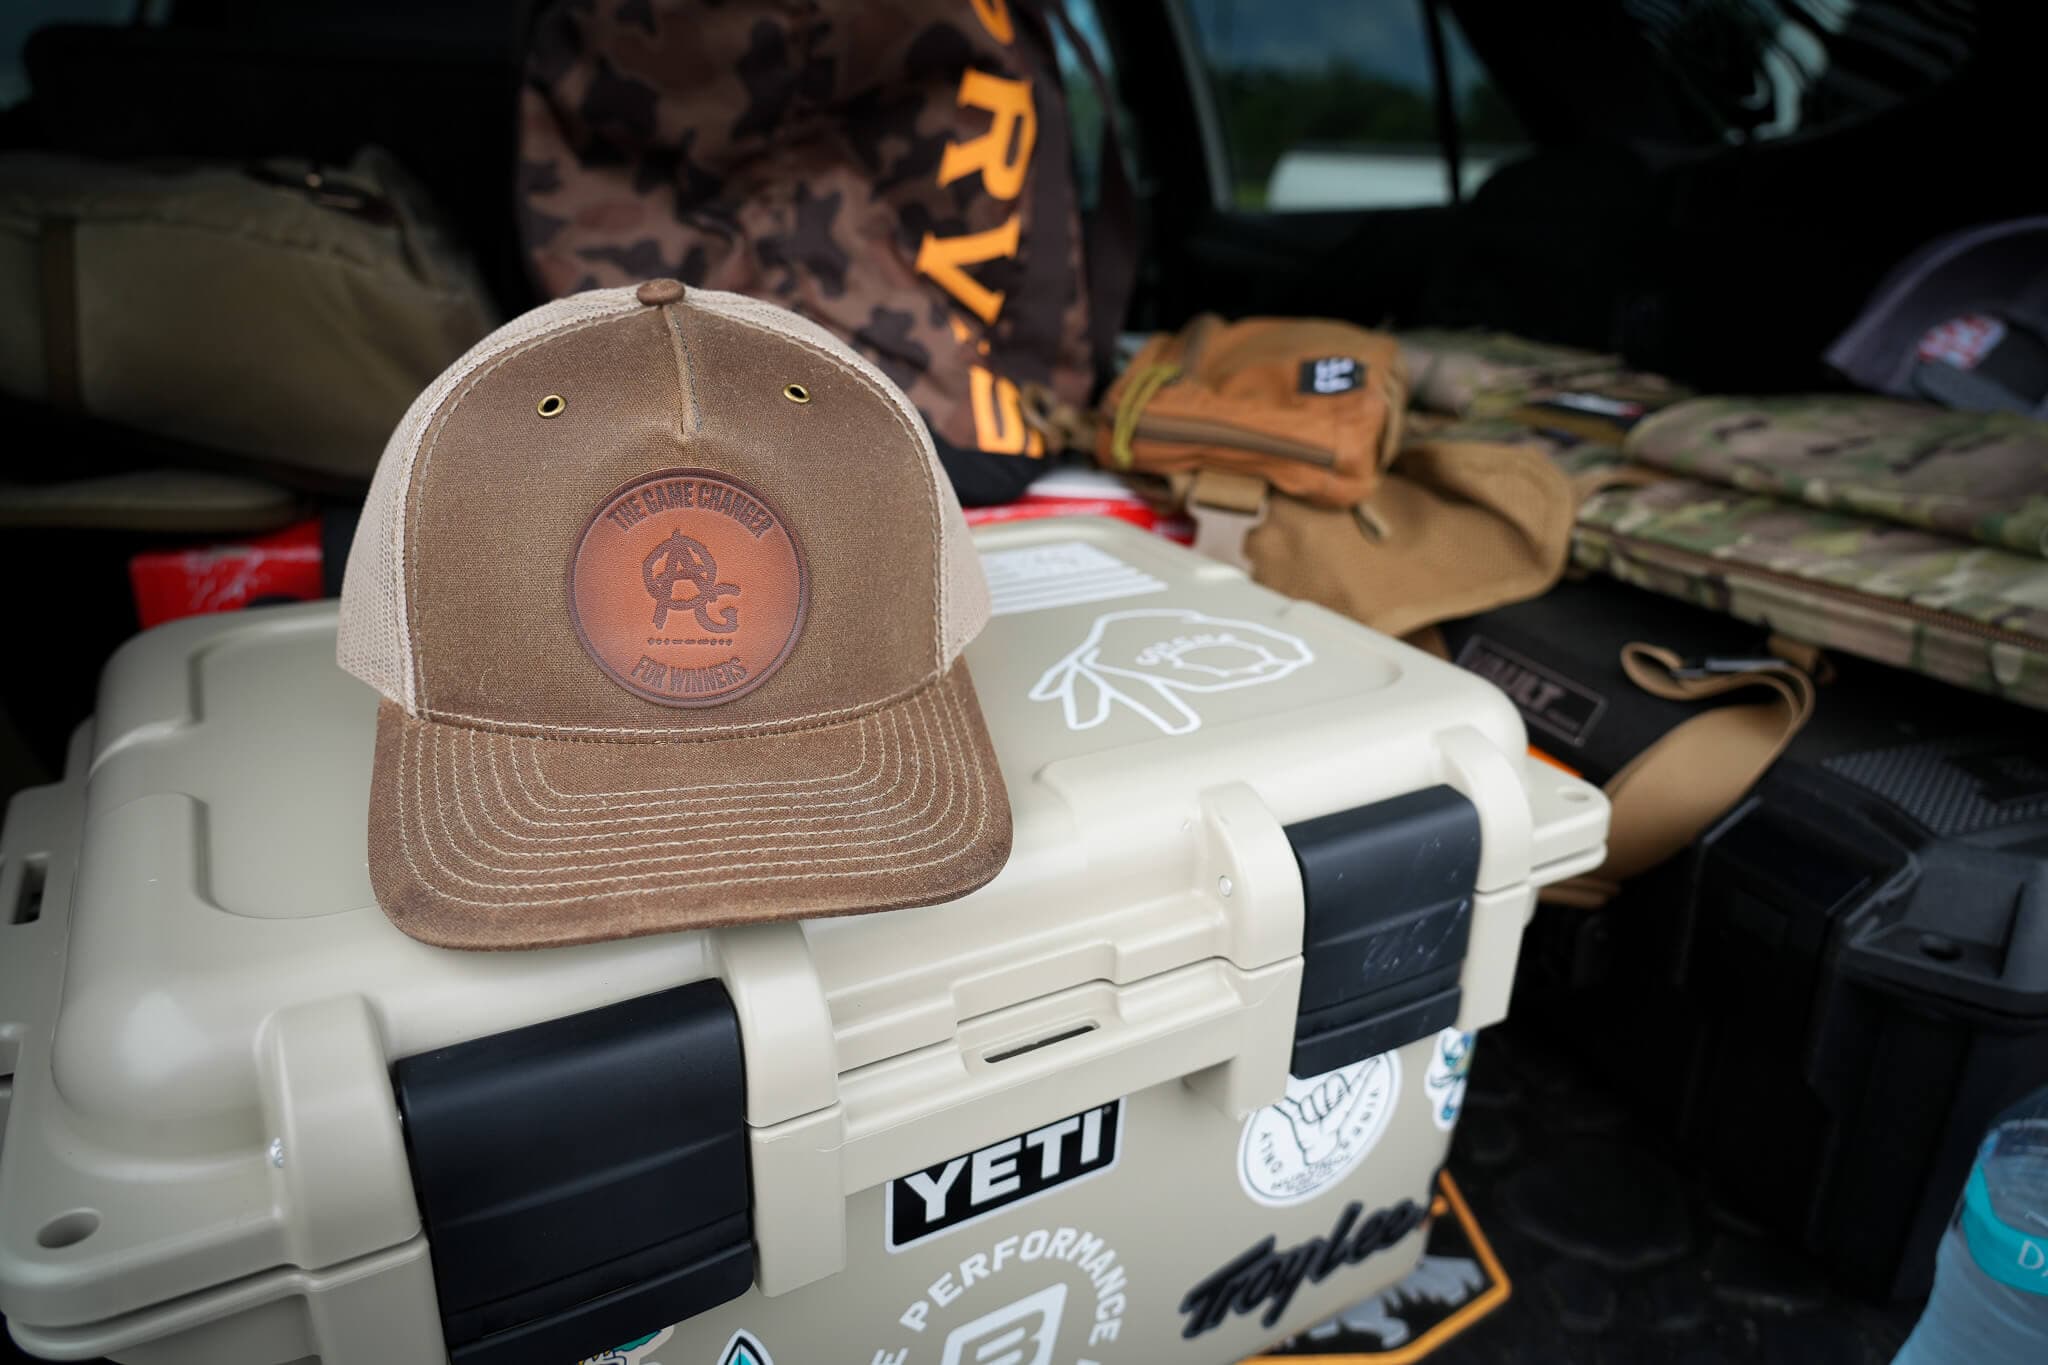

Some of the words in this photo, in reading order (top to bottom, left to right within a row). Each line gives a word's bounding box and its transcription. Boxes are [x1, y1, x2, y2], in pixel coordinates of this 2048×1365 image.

[606, 495, 649, 534] THE
[644, 483, 694, 515] GAME
[698, 481, 774, 539] CHANGER
[630, 654, 667, 689] FOR
[669, 657, 748, 693] WINNERS
[903, 1107, 1103, 1223] YETI
[899, 1227, 1128, 1347] PERFORMANCE
